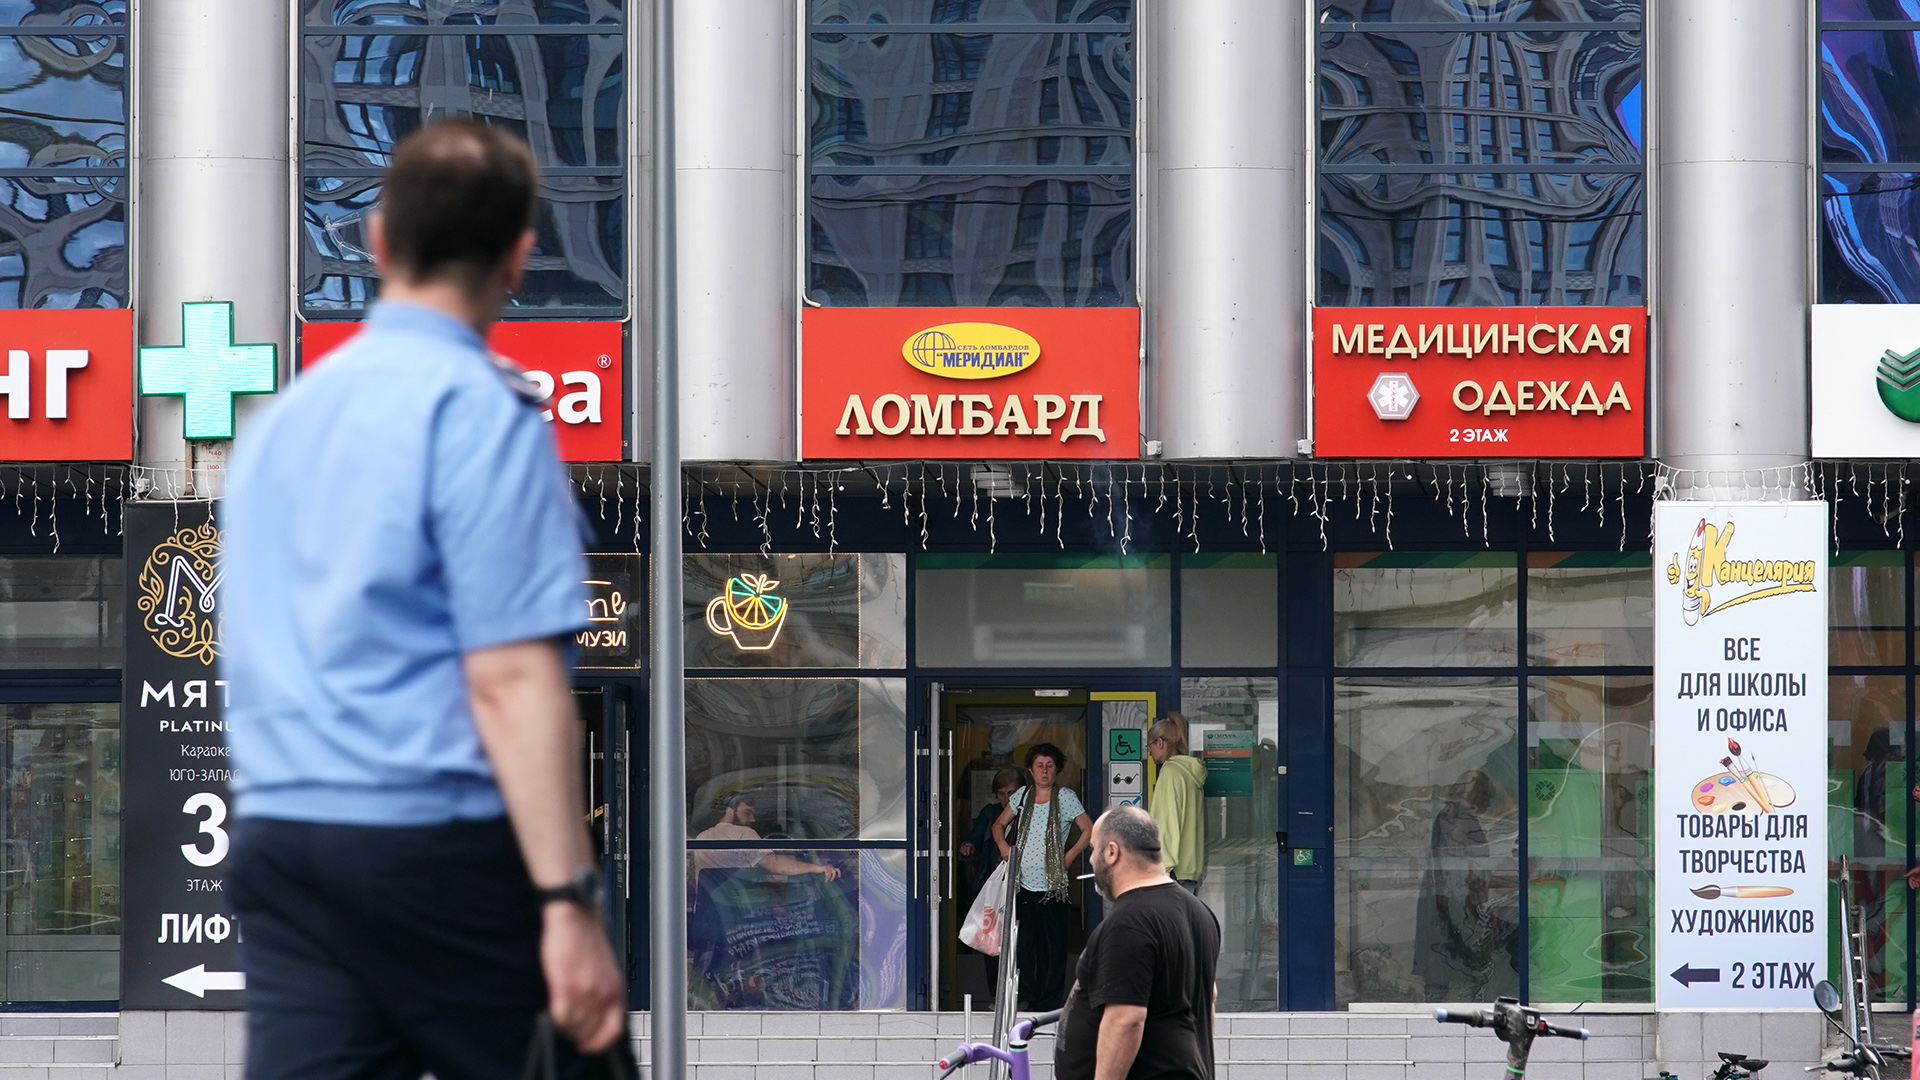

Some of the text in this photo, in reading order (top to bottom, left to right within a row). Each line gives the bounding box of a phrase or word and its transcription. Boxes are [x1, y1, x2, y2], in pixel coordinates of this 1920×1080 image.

[1332, 323, 1631, 359] МЕДИЦИНСКАЯ
[1452, 380, 1632, 416] ОДЕЖДА
[835, 393, 1106, 443] ЛОМБАРД
[1450, 428, 1508, 442] 2 ЭТАЖ
[1701, 521, 1816, 588] Канцелярия
[1724, 637, 1761, 661] ВСЕ
[1678, 673, 1806, 699] ДЛЯ ШКОЛЫ
[1697, 708, 1788, 731] И ОФИСА
[181, 792, 230, 867] 3
[1677, 815, 1808, 841] ТОВАРЫ ДЛЯ
[1679, 850, 1806, 873] ТВОРЧЕСТВА
[186, 879, 223, 892] ЭТАЖ
[1671, 909, 1815, 936] ХУДОЖНИКОВ
[1731, 962, 1815, 989] 2 ЭТАЖ
